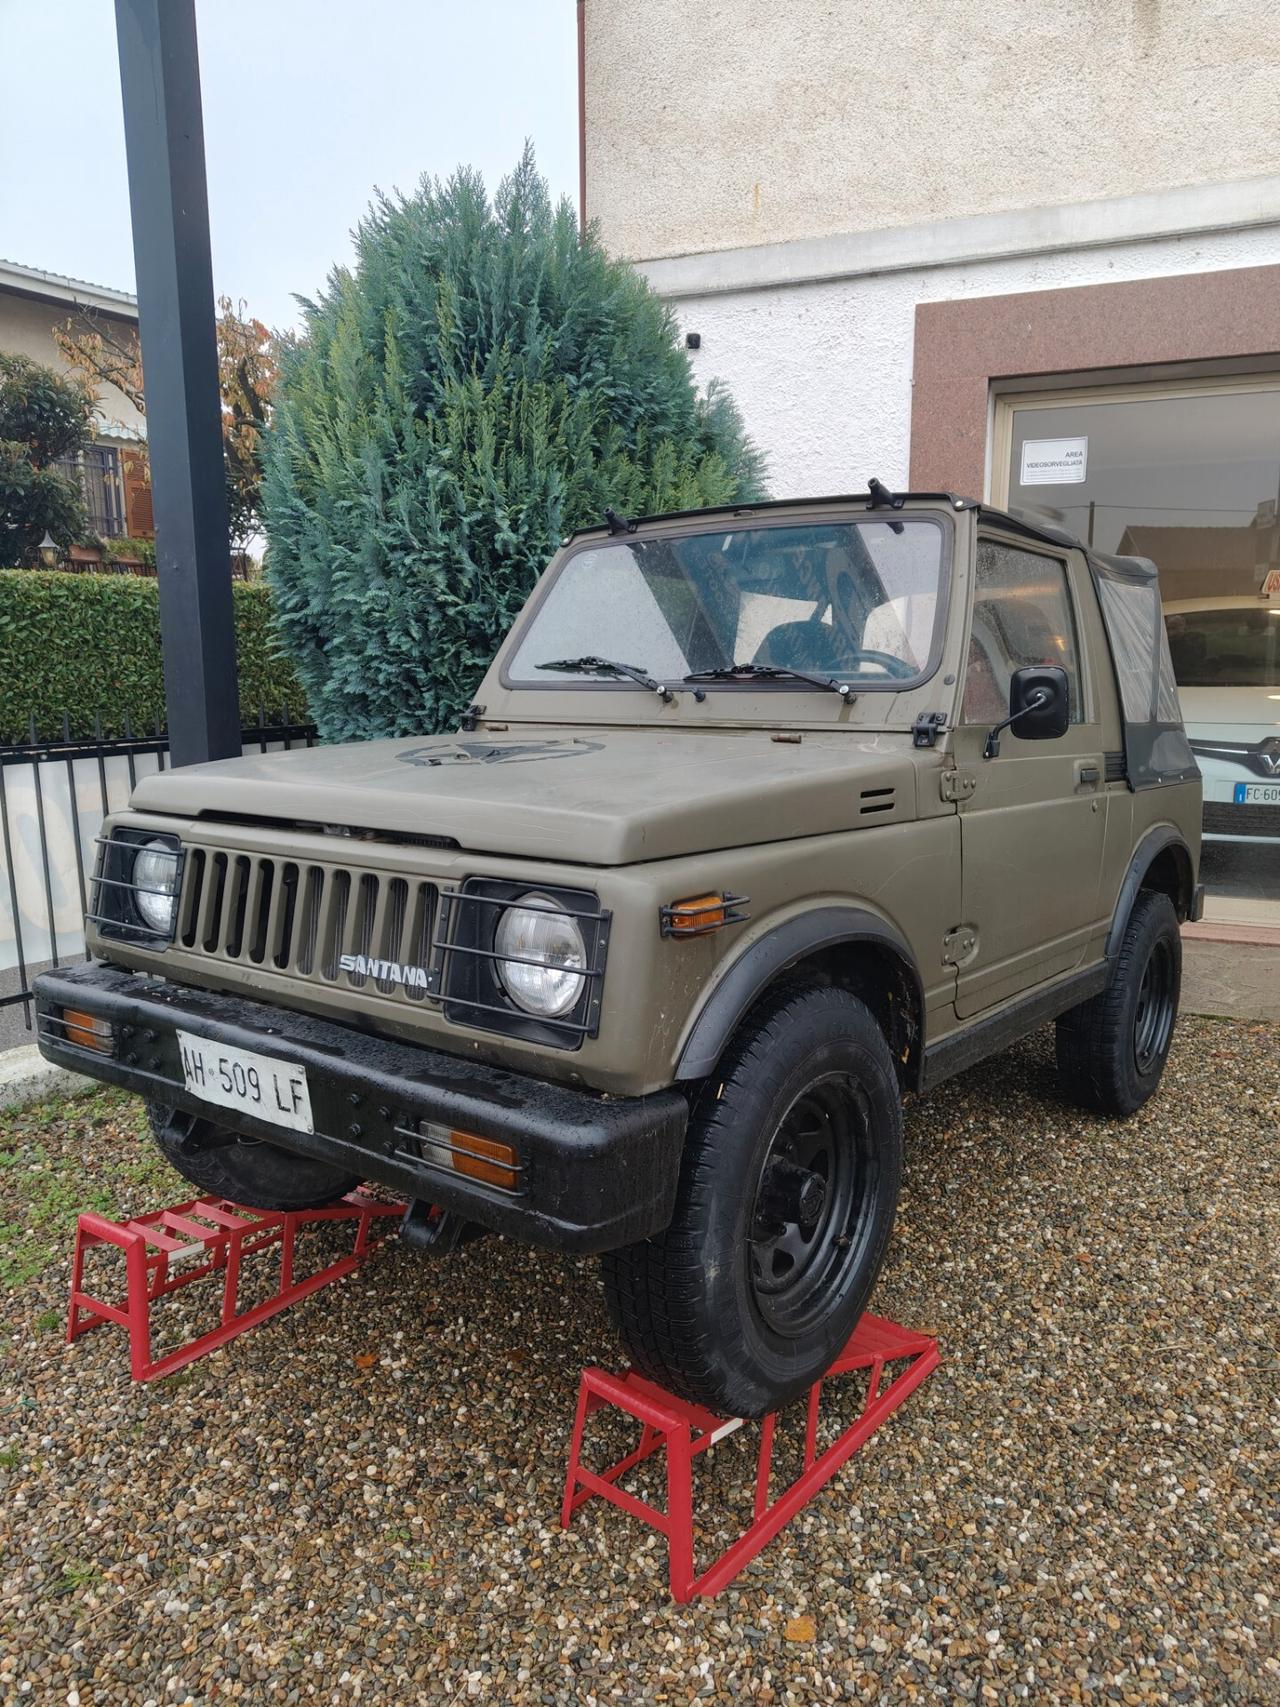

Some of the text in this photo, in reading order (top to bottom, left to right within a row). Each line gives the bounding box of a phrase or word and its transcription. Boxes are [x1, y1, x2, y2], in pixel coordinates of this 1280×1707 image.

[1026, 460, 1083, 468] VIDEOSORVEGLIATA
[1065, 450, 1083, 458] AREA
[339, 954, 428, 988] SANTANA
[183, 1046, 303, 1114] AH 509 LF
